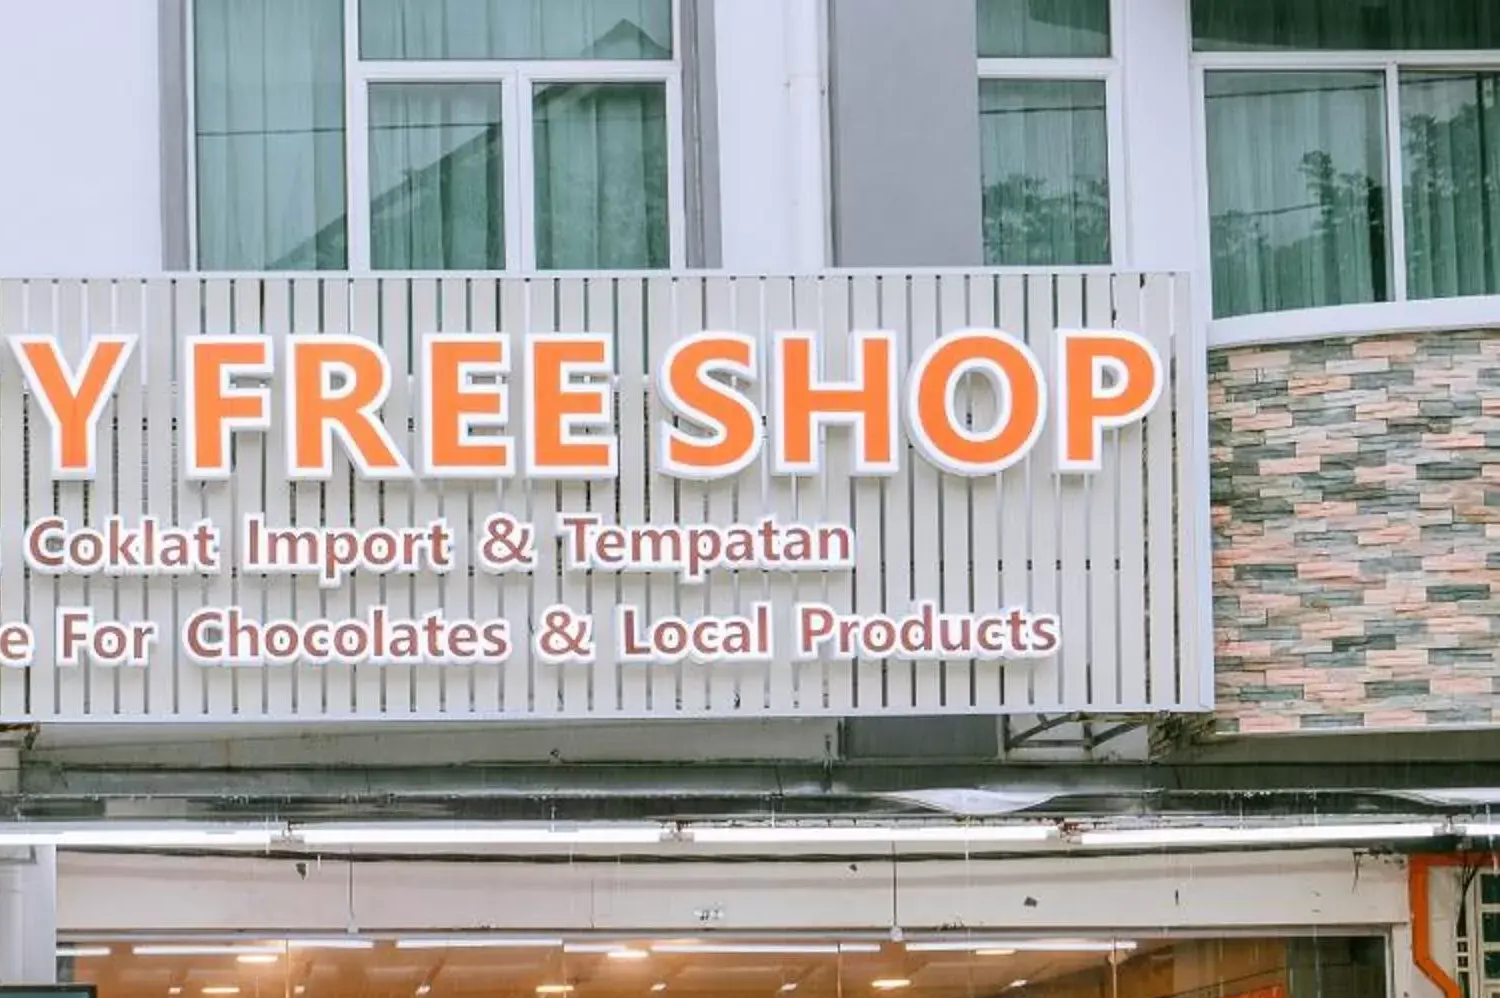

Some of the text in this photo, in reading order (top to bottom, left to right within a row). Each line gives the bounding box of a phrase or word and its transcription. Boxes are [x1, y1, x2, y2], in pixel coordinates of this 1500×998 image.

[190, 337, 614, 472] FREE
[666, 334, 1158, 470] SHOP
[27, 518, 218, 568] Coklat
[246, 518, 452, 580] Import
[482, 517, 534, 565] &
[562, 517, 852, 577] Tempatan
[61, 612, 155, 660] For
[186, 608, 510, 659] Chocolates
[539, 610, 593, 657] &
[622, 605, 769, 656] Local
[801, 603, 1058, 653] Products
